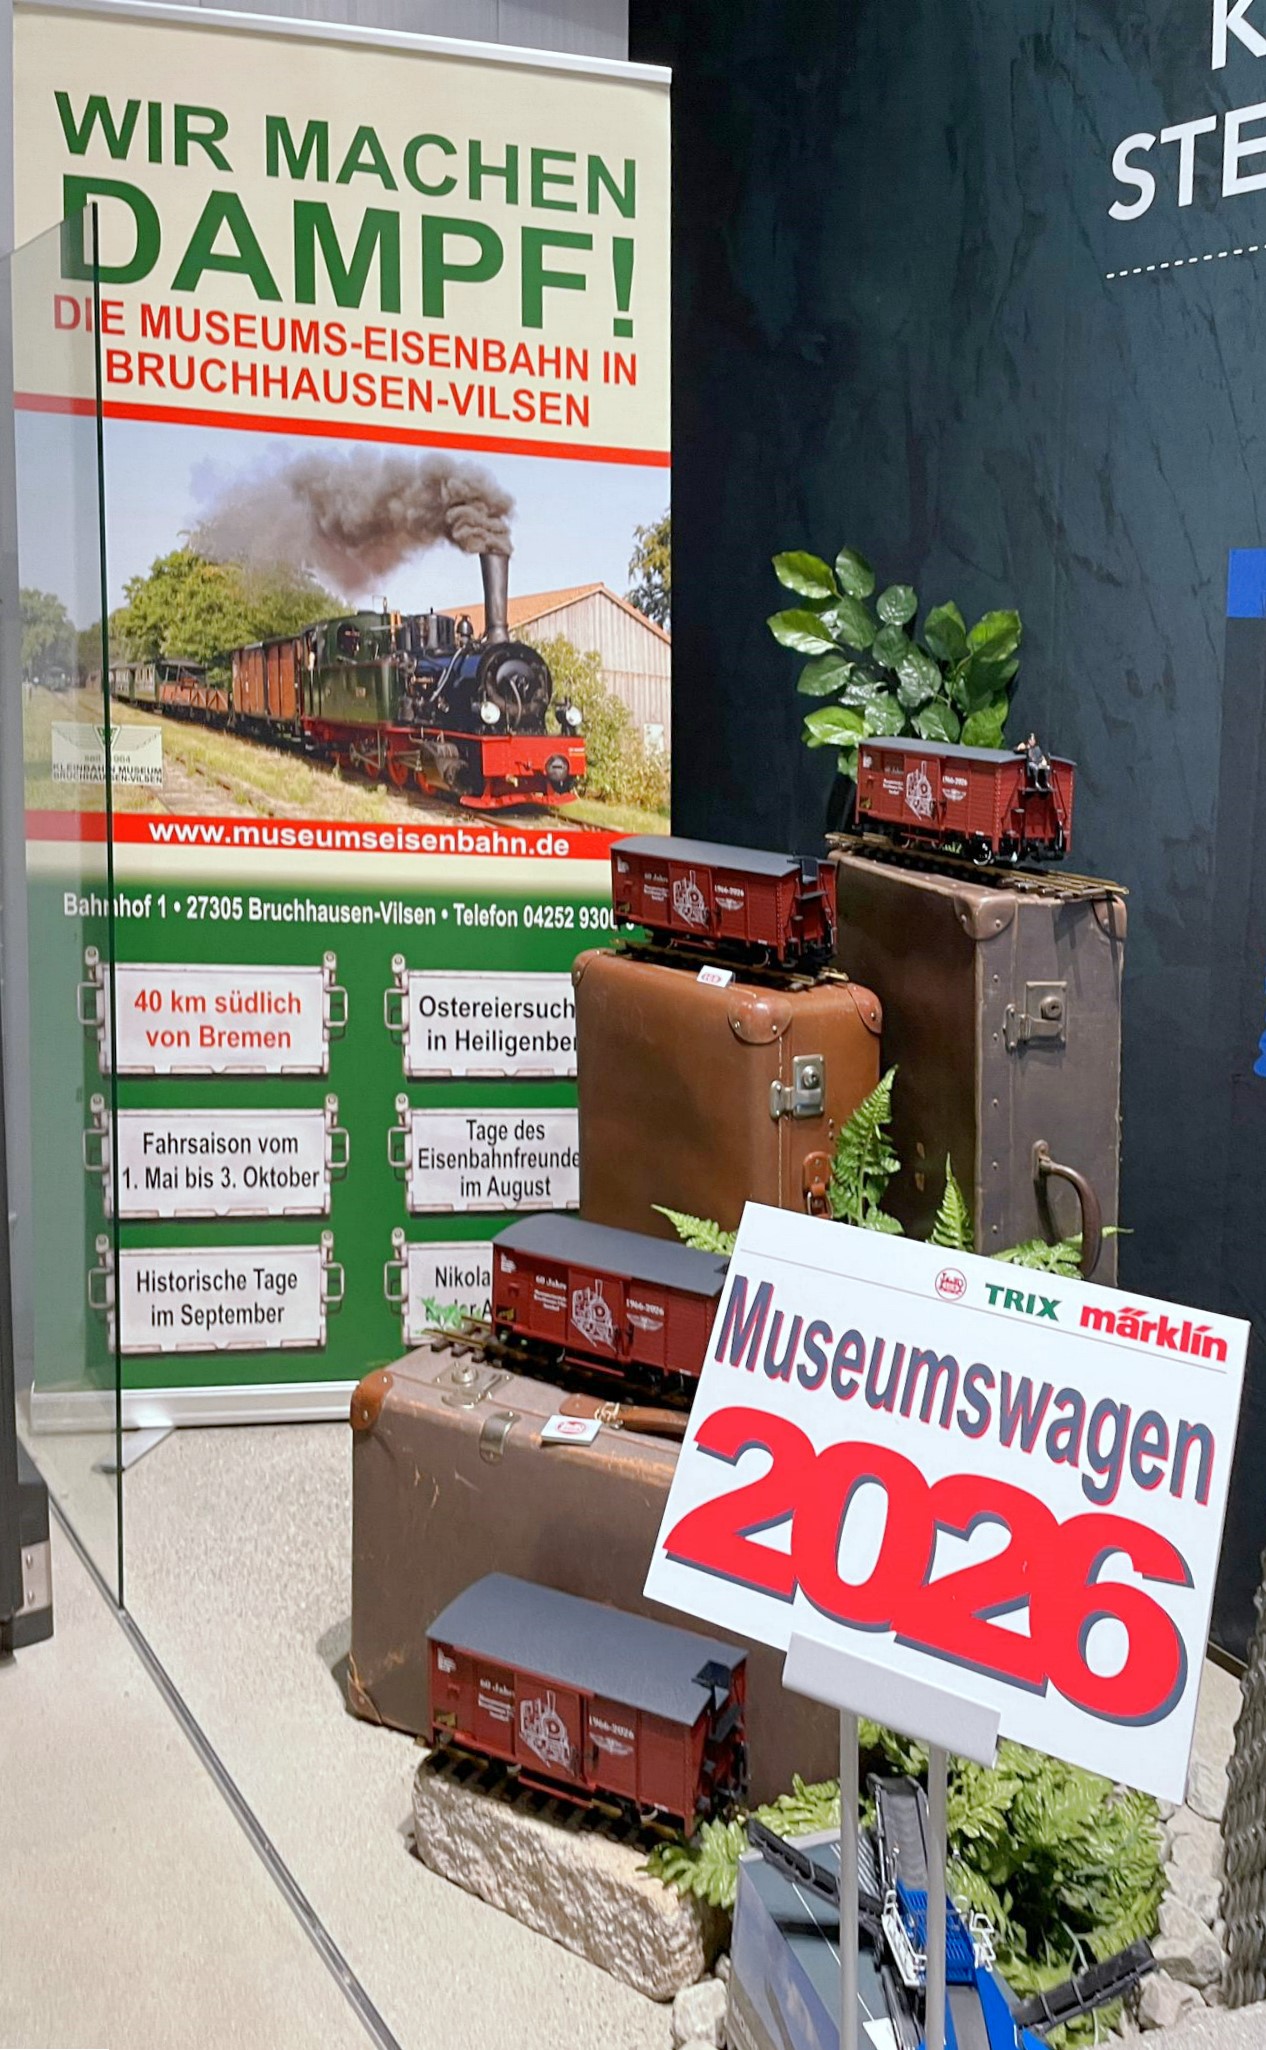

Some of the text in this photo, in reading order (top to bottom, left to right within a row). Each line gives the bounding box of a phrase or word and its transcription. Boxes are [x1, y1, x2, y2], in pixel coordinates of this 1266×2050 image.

[54, 91, 637, 219] WIR MACHEN
[1108, 102, 1266, 221] STE
[60, 173, 635, 338] DAMPF!
[53, 294, 638, 386] DIE MUSEUMS-EISENBAHN IN
[105, 348, 590, 428] BRUCHHAUSEN-VILSEN
[148, 822, 570, 857] www.museumseisenbahn.de
[63, 892, 151, 918] Bahnhof
[157, 894, 166, 919] 1
[187, 896, 243, 920] 27305
[249, 897, 436, 926] Bruchhausen-Vilsen
[453, 903, 518, 928] Telefon
[523, 905, 574, 929] 04252
[134, 990, 301, 1015] 40 km südlich
[419, 995, 575, 1020] Ostereiersuch
[145, 1025, 291, 1049] von Bremen
[427, 1029, 446, 1051] in
[143, 1132, 299, 1155] Fahrsaison vom
[466, 1119, 545, 1145] Tage des
[418, 1147, 580, 1171] Eisenbahnfreunde
[122, 1165, 320, 1190] 1. Mai bis 3. Oktober
[460, 1175, 551, 1202] im August
[136, 1268, 298, 1295] Historische Tage
[151, 1303, 285, 1331] im September
[985, 1283, 1062, 1322] TRIX
[1080, 1305, 1228, 1362] märklin
[714, 1275, 1215, 1506] Museumswagen
[663, 1405, 1195, 1728] 2026
